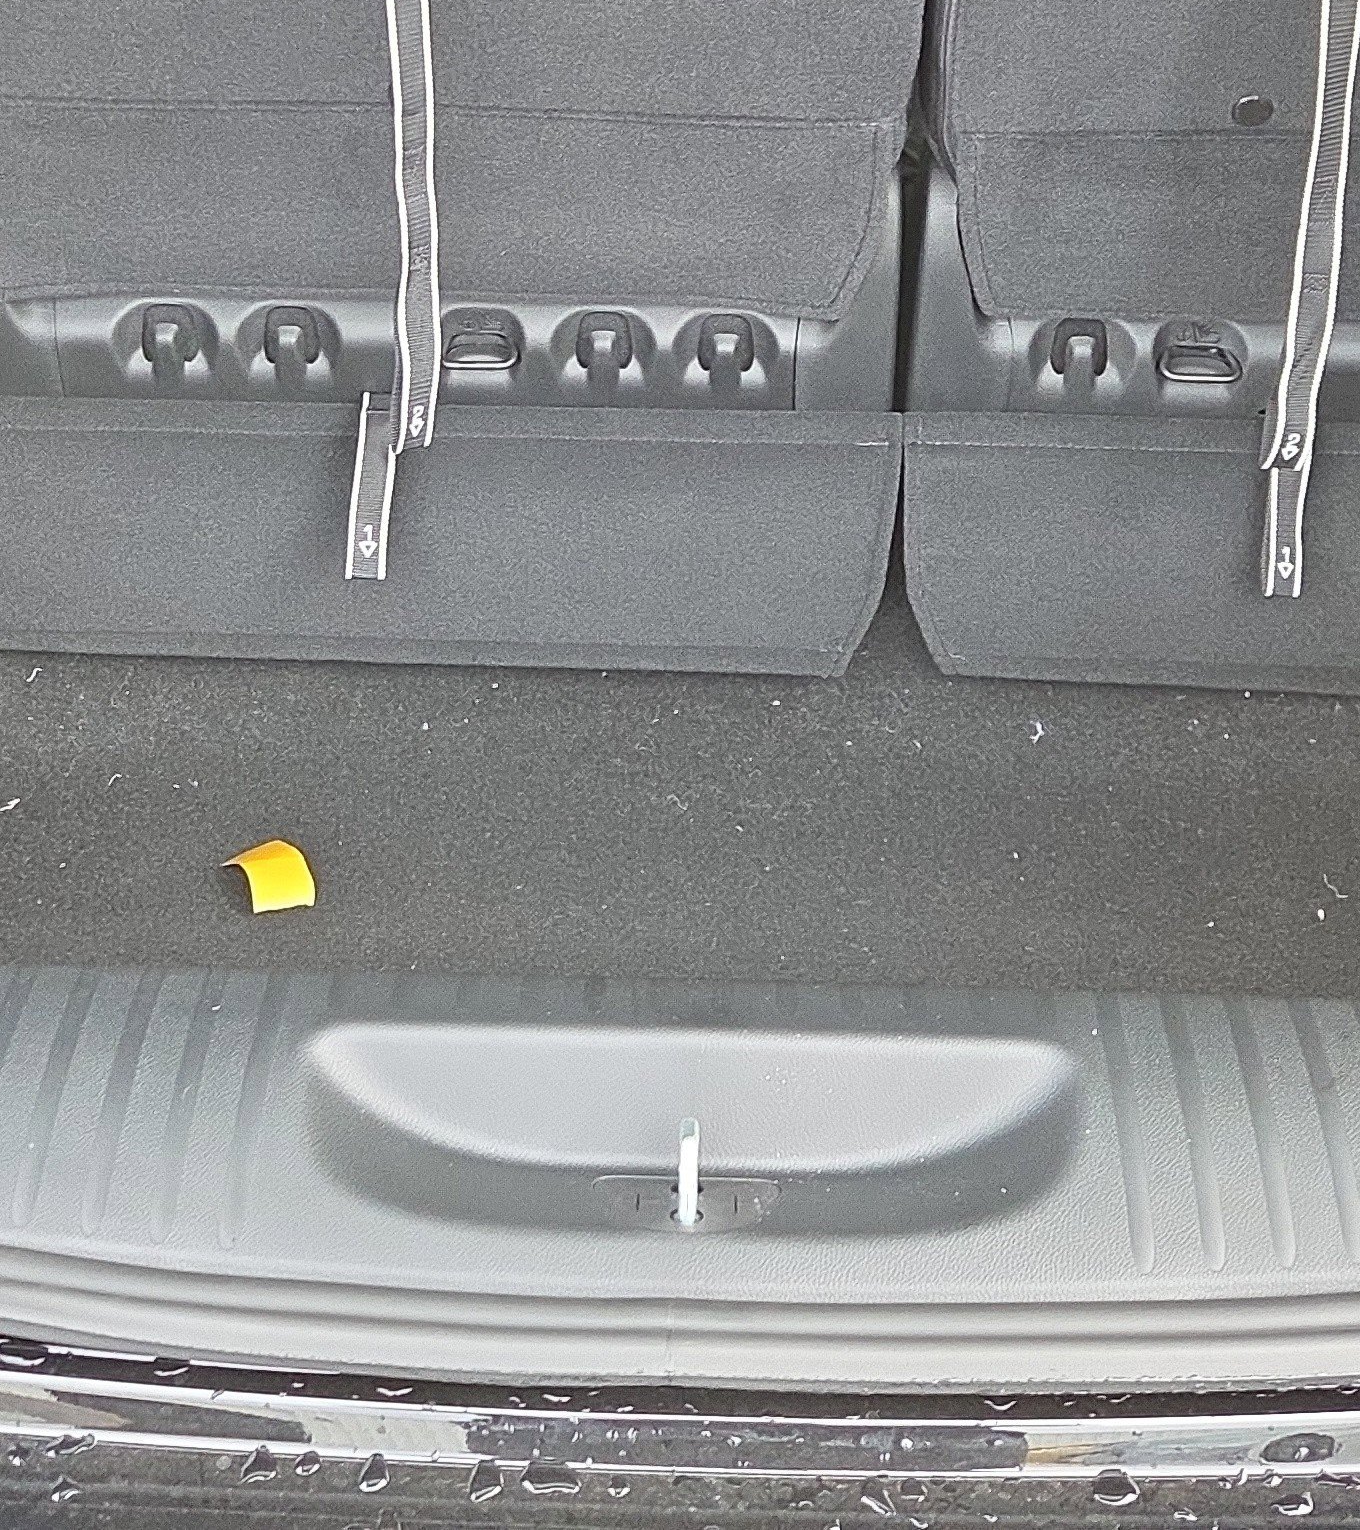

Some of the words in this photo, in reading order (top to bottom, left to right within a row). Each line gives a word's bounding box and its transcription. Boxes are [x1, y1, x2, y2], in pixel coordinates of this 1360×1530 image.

[412, 405, 425, 420] 2
[1287, 432, 1301, 446] 2
[363, 524, 373, 541] 1
[1281, 546, 1291, 563] 1
